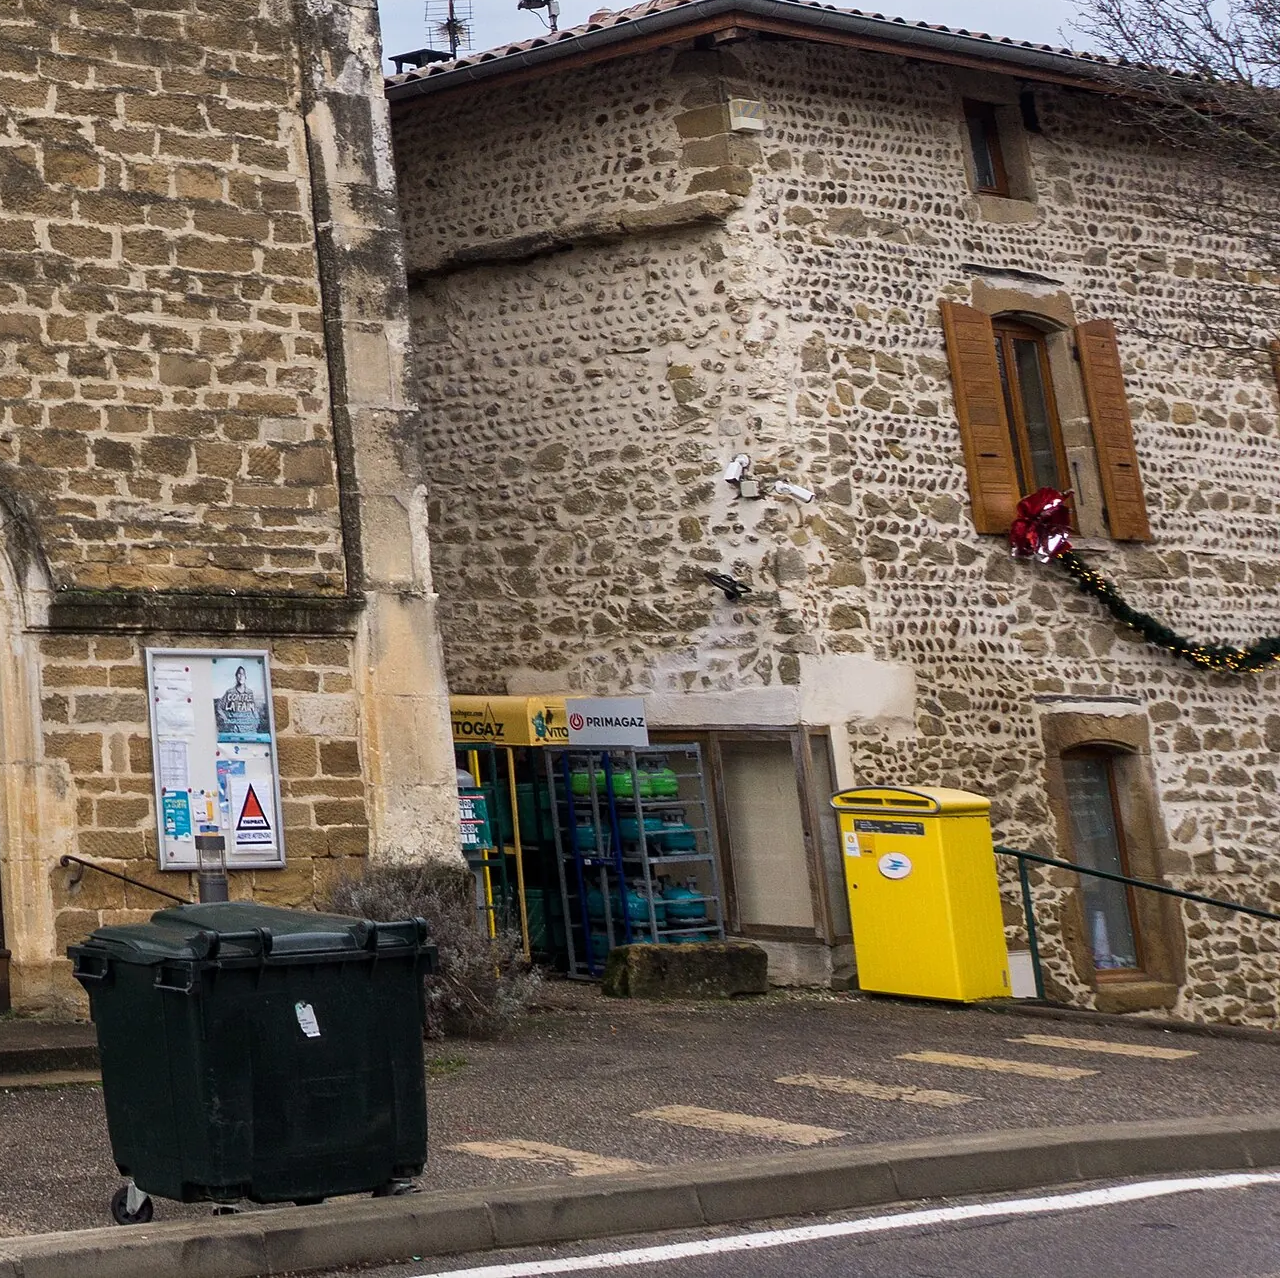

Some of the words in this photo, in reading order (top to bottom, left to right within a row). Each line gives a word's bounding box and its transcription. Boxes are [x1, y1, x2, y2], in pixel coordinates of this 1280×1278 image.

[225, 702, 236, 712] LA
[237, 702, 255, 712] FAIM
[586, 716, 645, 728] PRIMAGAZ
